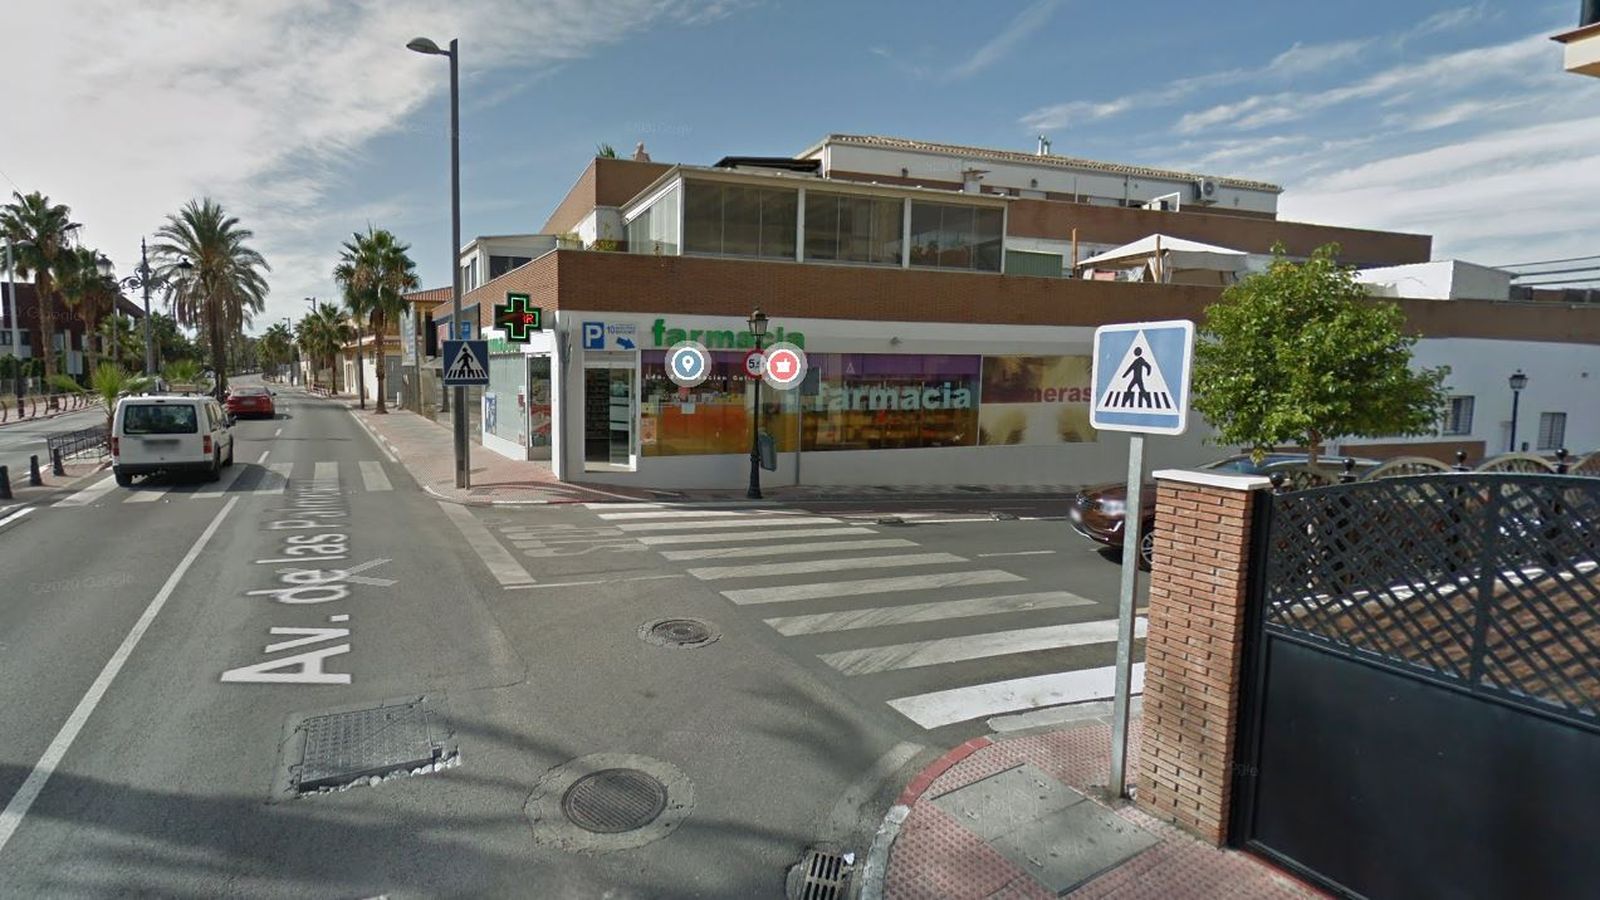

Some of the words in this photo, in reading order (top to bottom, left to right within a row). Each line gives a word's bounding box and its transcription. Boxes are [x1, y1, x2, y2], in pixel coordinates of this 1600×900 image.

[586, 325, 603, 348] P
[652, 318, 805, 350] farmacia
[815, 381, 971, 411] farmacia
